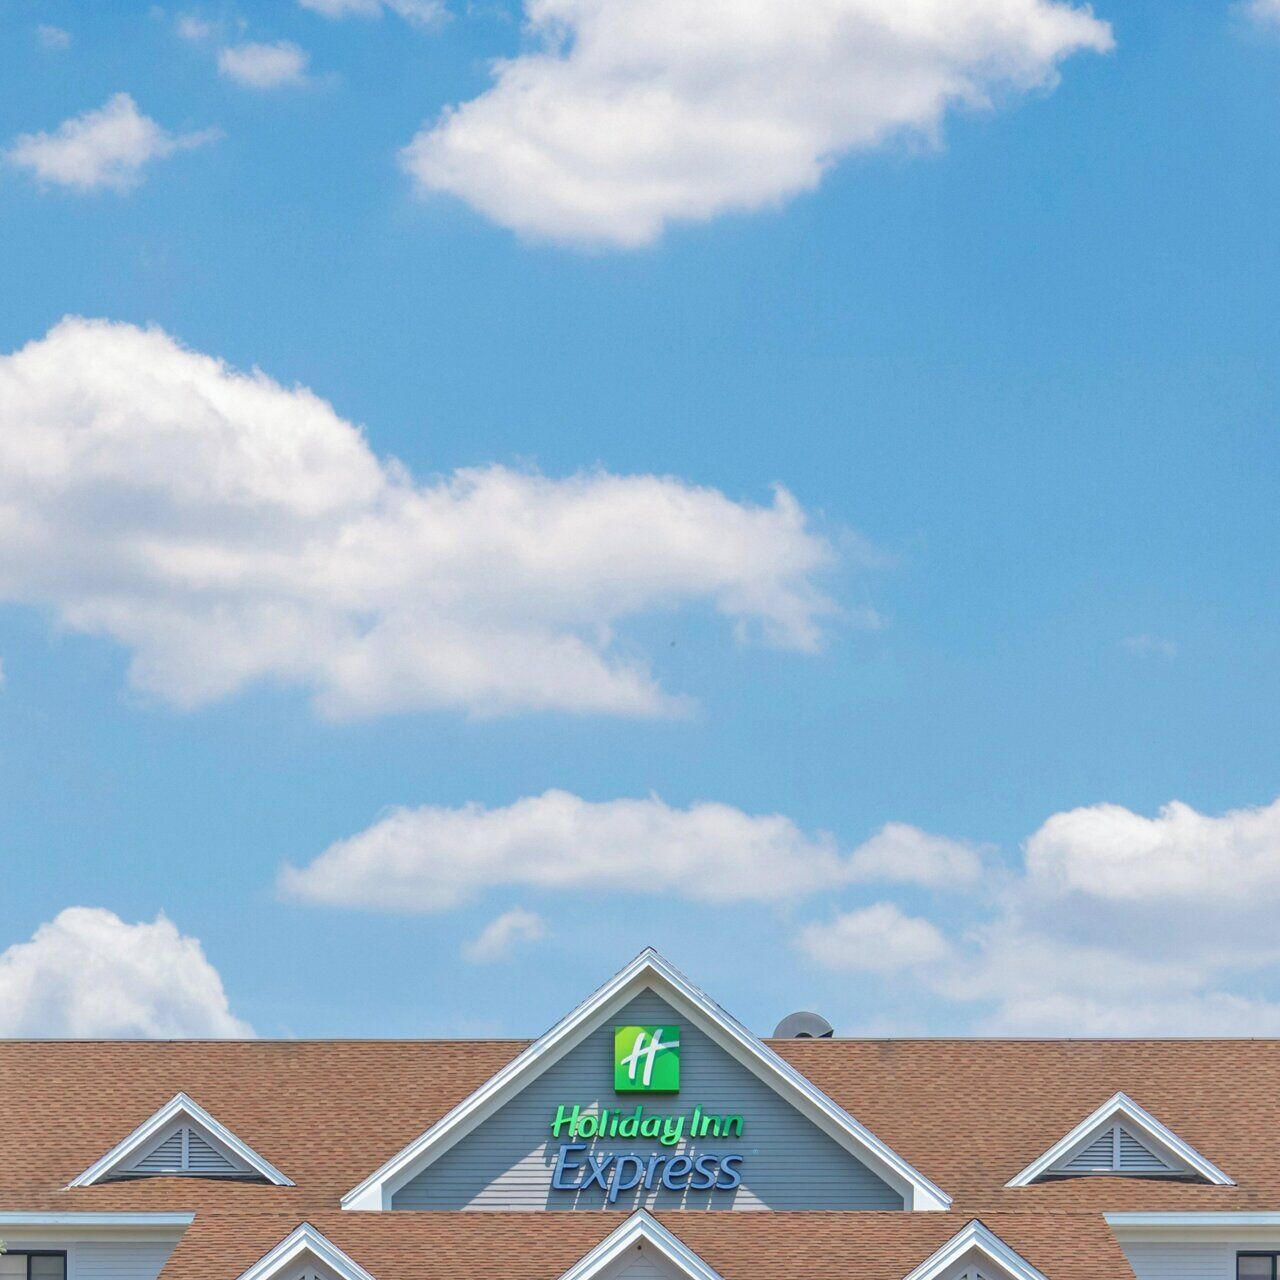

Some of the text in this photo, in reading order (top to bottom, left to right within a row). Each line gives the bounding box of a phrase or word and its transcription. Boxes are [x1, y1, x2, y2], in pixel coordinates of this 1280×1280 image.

[550, 1103, 745, 1146] Holiday Inn
[552, 1143, 744, 1203] Express
